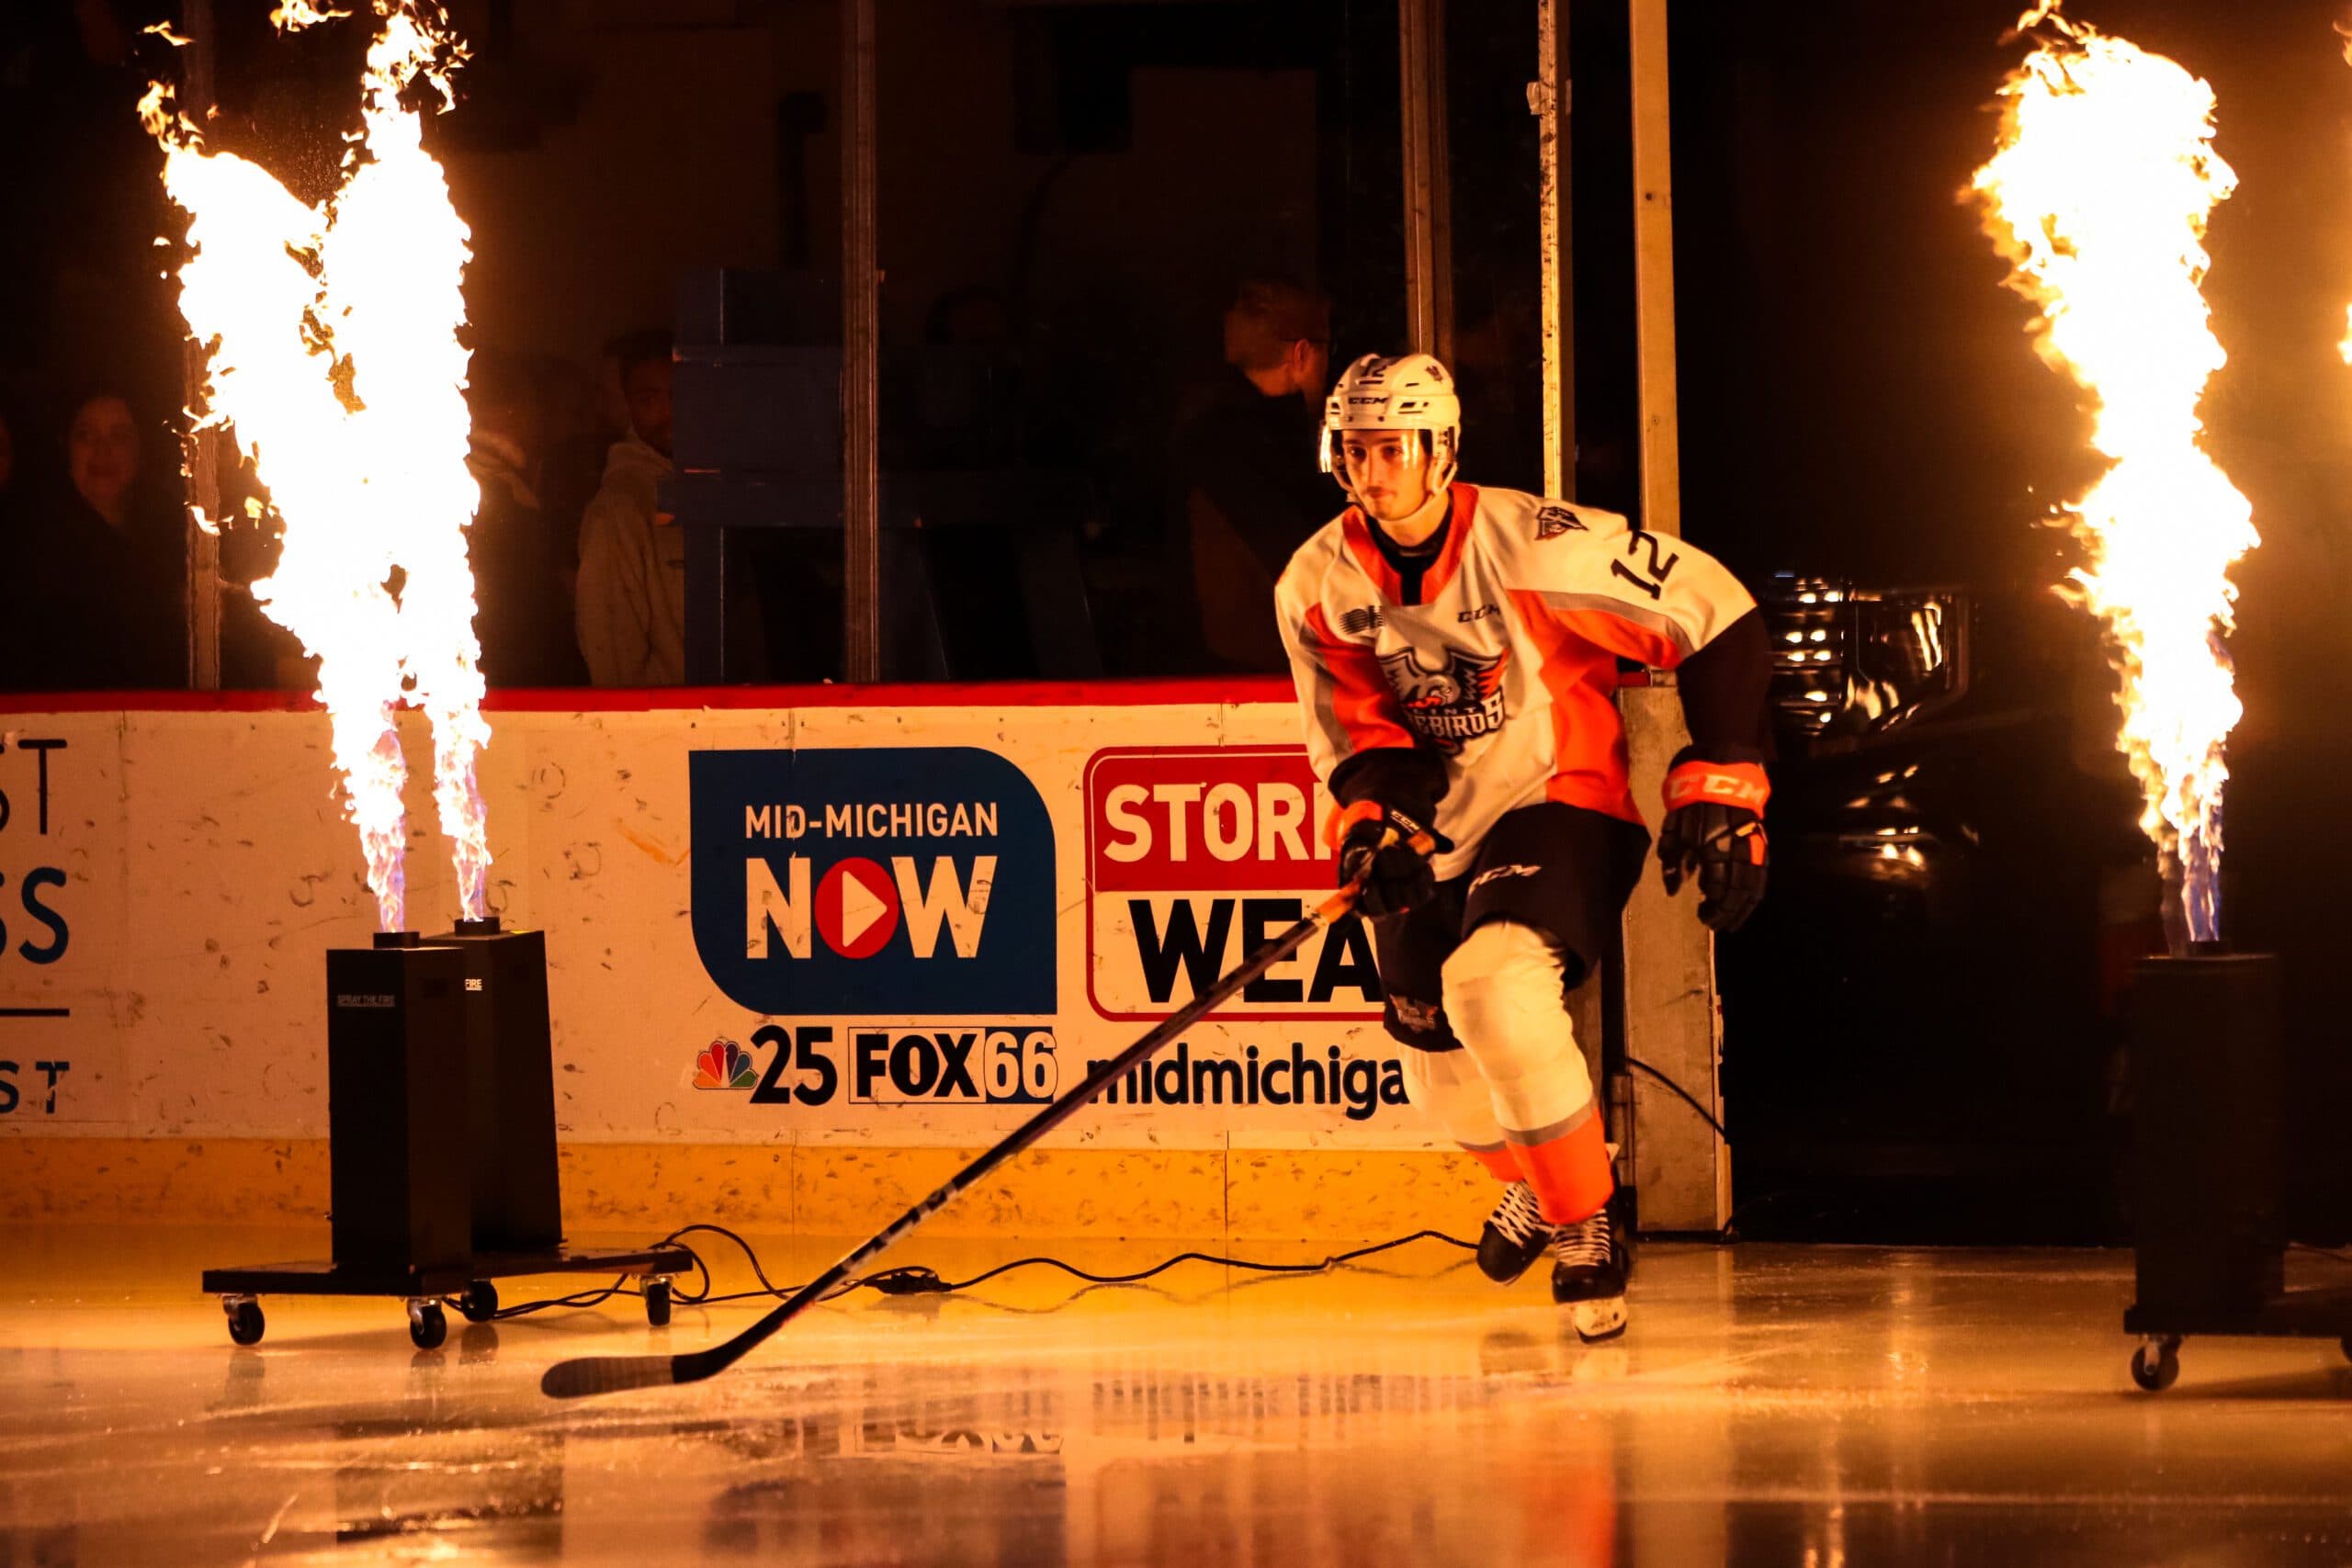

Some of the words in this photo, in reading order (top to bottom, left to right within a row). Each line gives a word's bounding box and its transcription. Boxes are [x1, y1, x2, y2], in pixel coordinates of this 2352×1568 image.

[1611, 530, 1679, 600] 12
[1458, 604, 1501, 623] CCM
[0, 739, 67, 835] T
[745, 802, 999, 840] MID-MICHIGAN
[0, 866, 70, 964] S
[746, 855, 998, 959] NOW
[749, 1024, 838, 1106] 25
[856, 1033, 980, 1098] FOX
[984, 1031, 1058, 1099] 66
